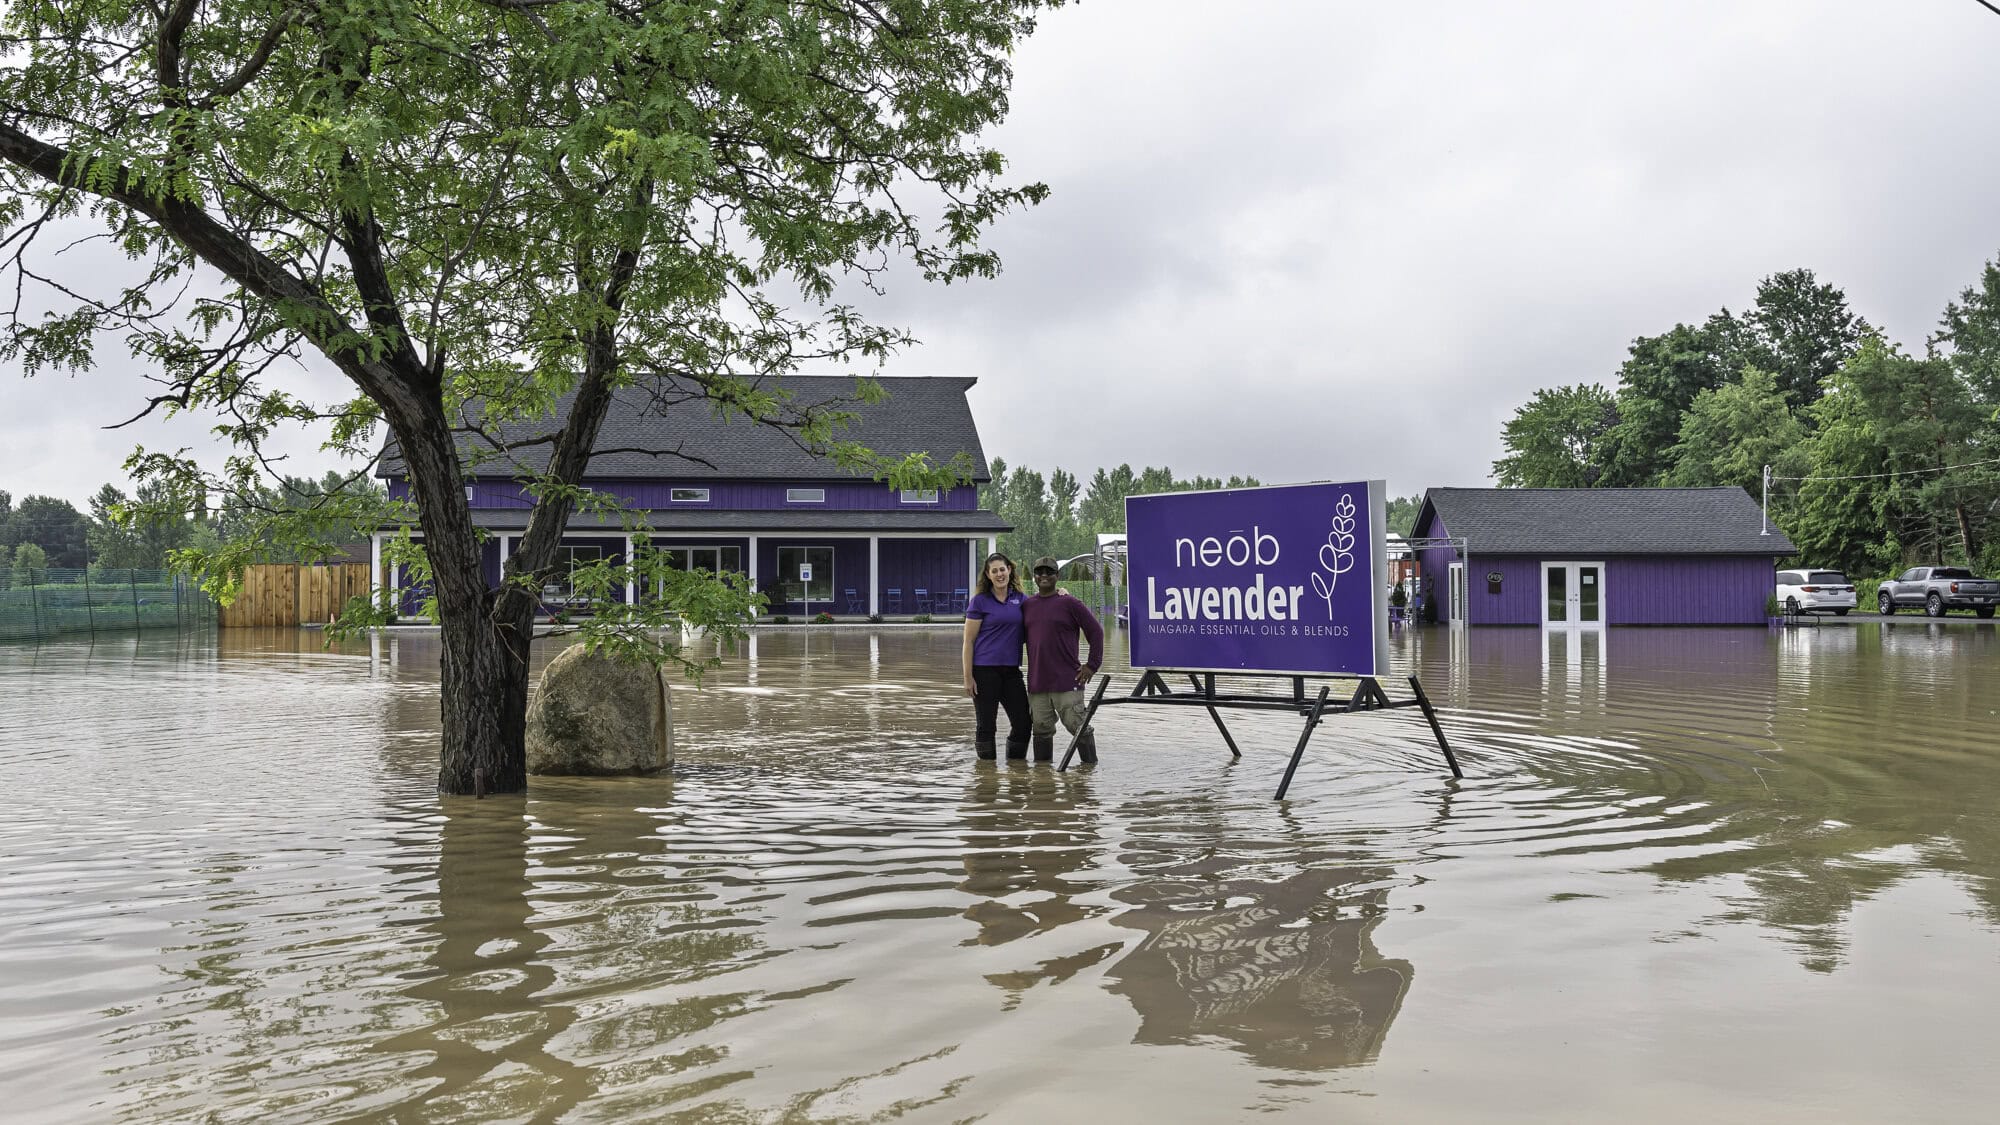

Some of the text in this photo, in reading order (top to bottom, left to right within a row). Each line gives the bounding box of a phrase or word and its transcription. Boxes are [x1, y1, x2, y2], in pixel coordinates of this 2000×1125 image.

[1176, 526, 1280, 567] neōb
[1147, 574, 1304, 620] Lavender
[1148, 624, 1349, 636] NIAGARA ESSENTIAL OILS & BLENDS
